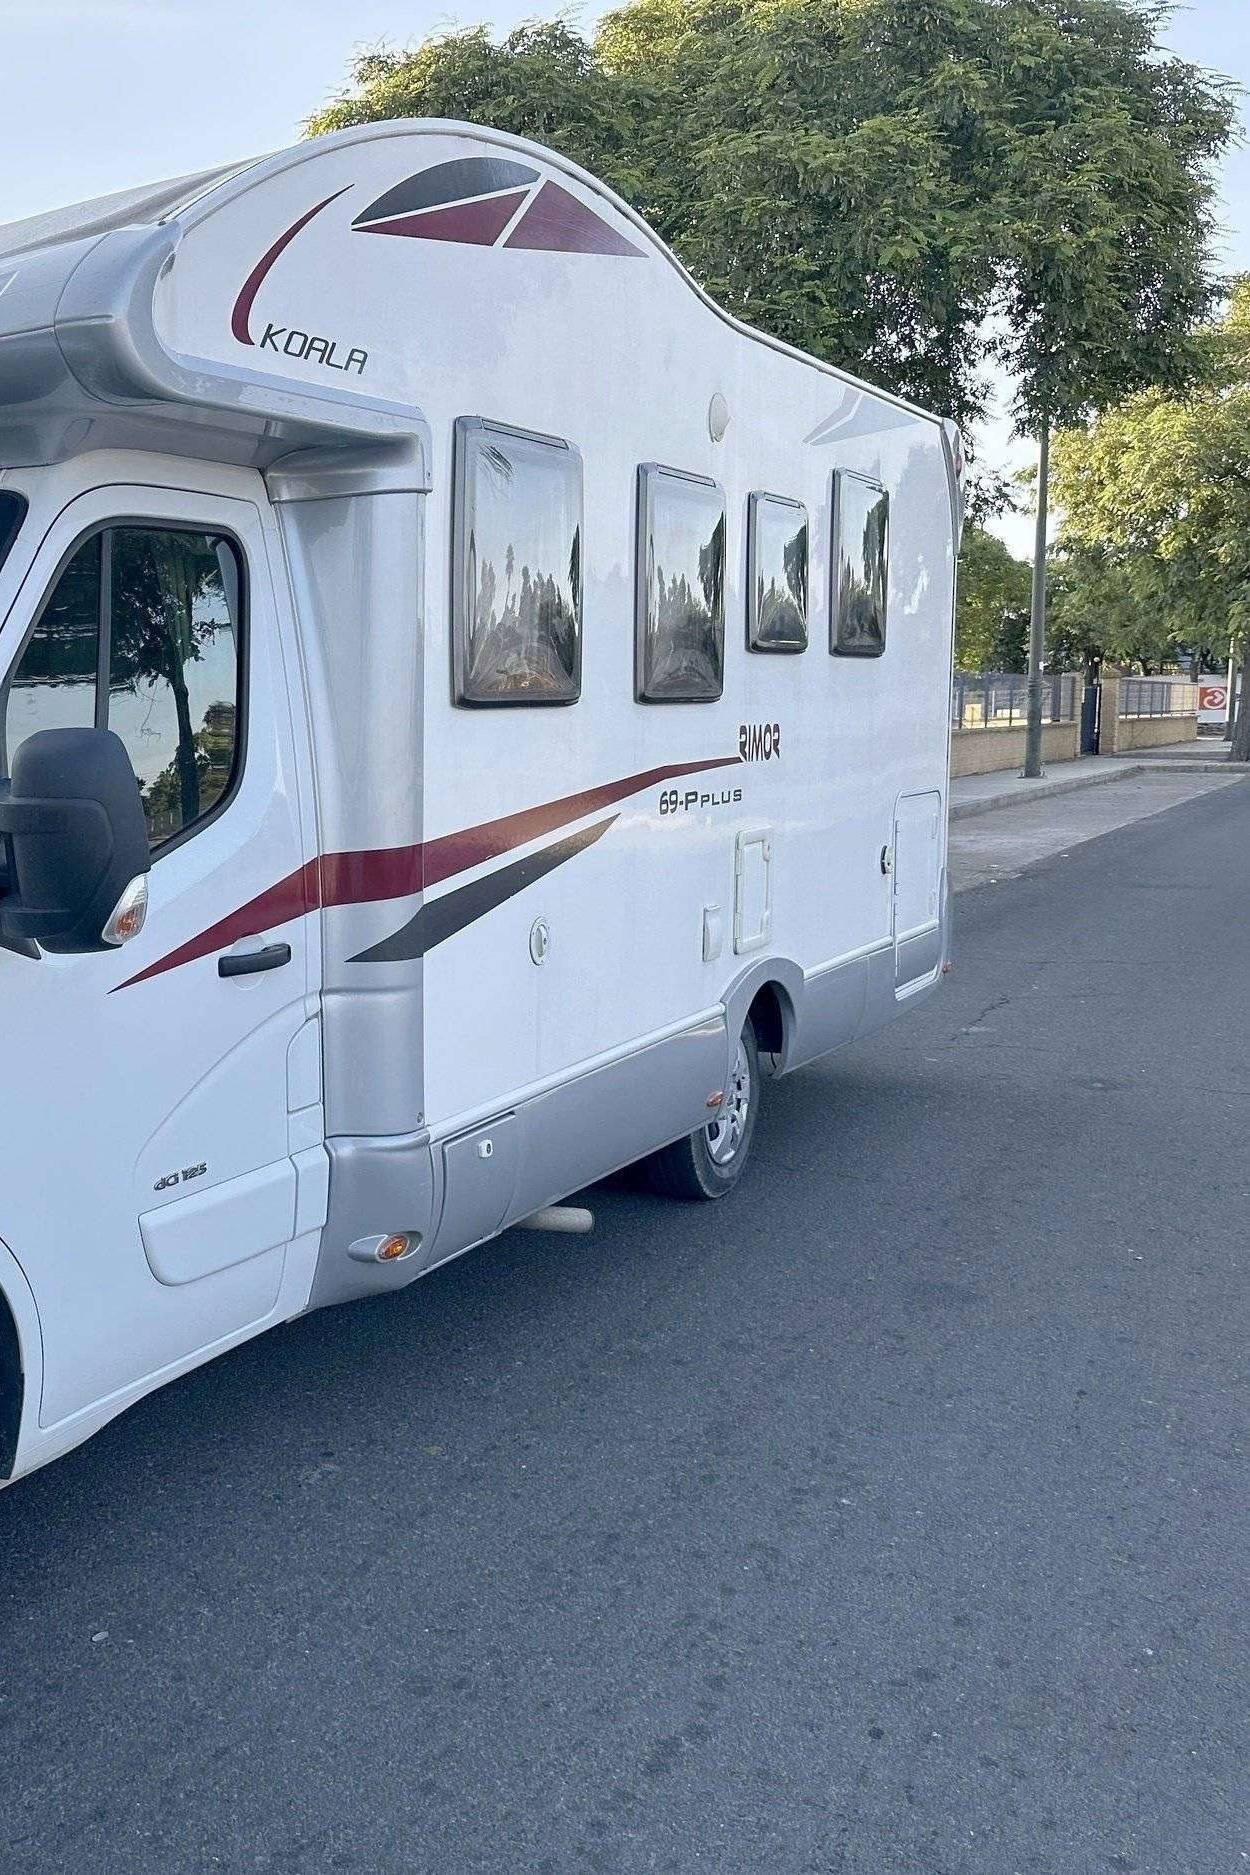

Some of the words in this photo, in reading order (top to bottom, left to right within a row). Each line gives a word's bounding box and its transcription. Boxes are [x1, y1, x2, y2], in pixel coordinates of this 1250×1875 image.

[259, 322, 369, 375] KOALA
[739, 723, 781, 762] RIMOR
[181, 1162, 207, 1181] 125
